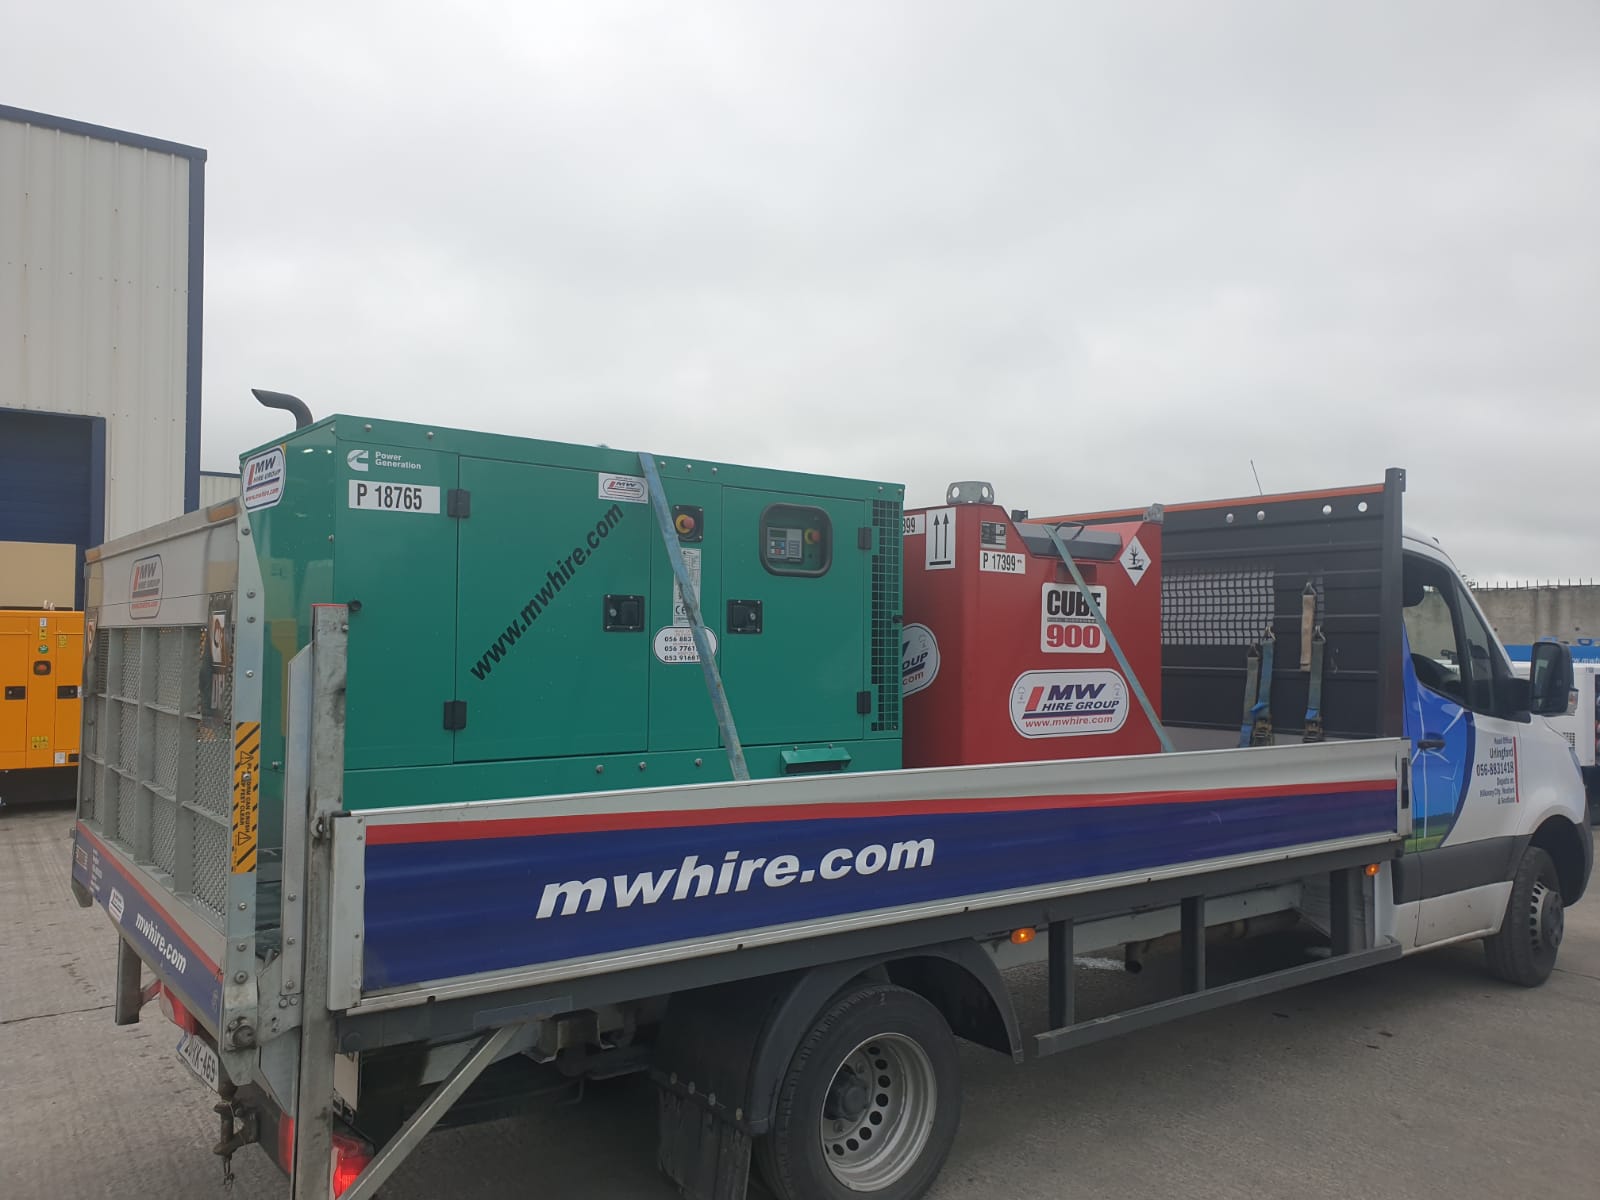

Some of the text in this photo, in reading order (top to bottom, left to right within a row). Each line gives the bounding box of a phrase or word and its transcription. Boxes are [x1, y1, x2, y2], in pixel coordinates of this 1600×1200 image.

[255, 456, 276, 474] MW
[375, 451, 402, 461] Power
[375, 459, 422, 470] Generation
[356, 483, 422, 510] P 18765
[140, 561, 157, 580] MW
[983, 553, 1016, 571] P 17399
[470, 503, 624, 681] www.mwhire.com
[1046, 624, 1101, 648] 900
[1047, 683, 1106, 701] MW
[1041, 700, 1119, 712] HIRE GROUP
[1025, 716, 1113, 728] www.mwhire.com
[536, 838, 935, 919] mwhire.com
[135, 912, 187, 974] mwhire.com
